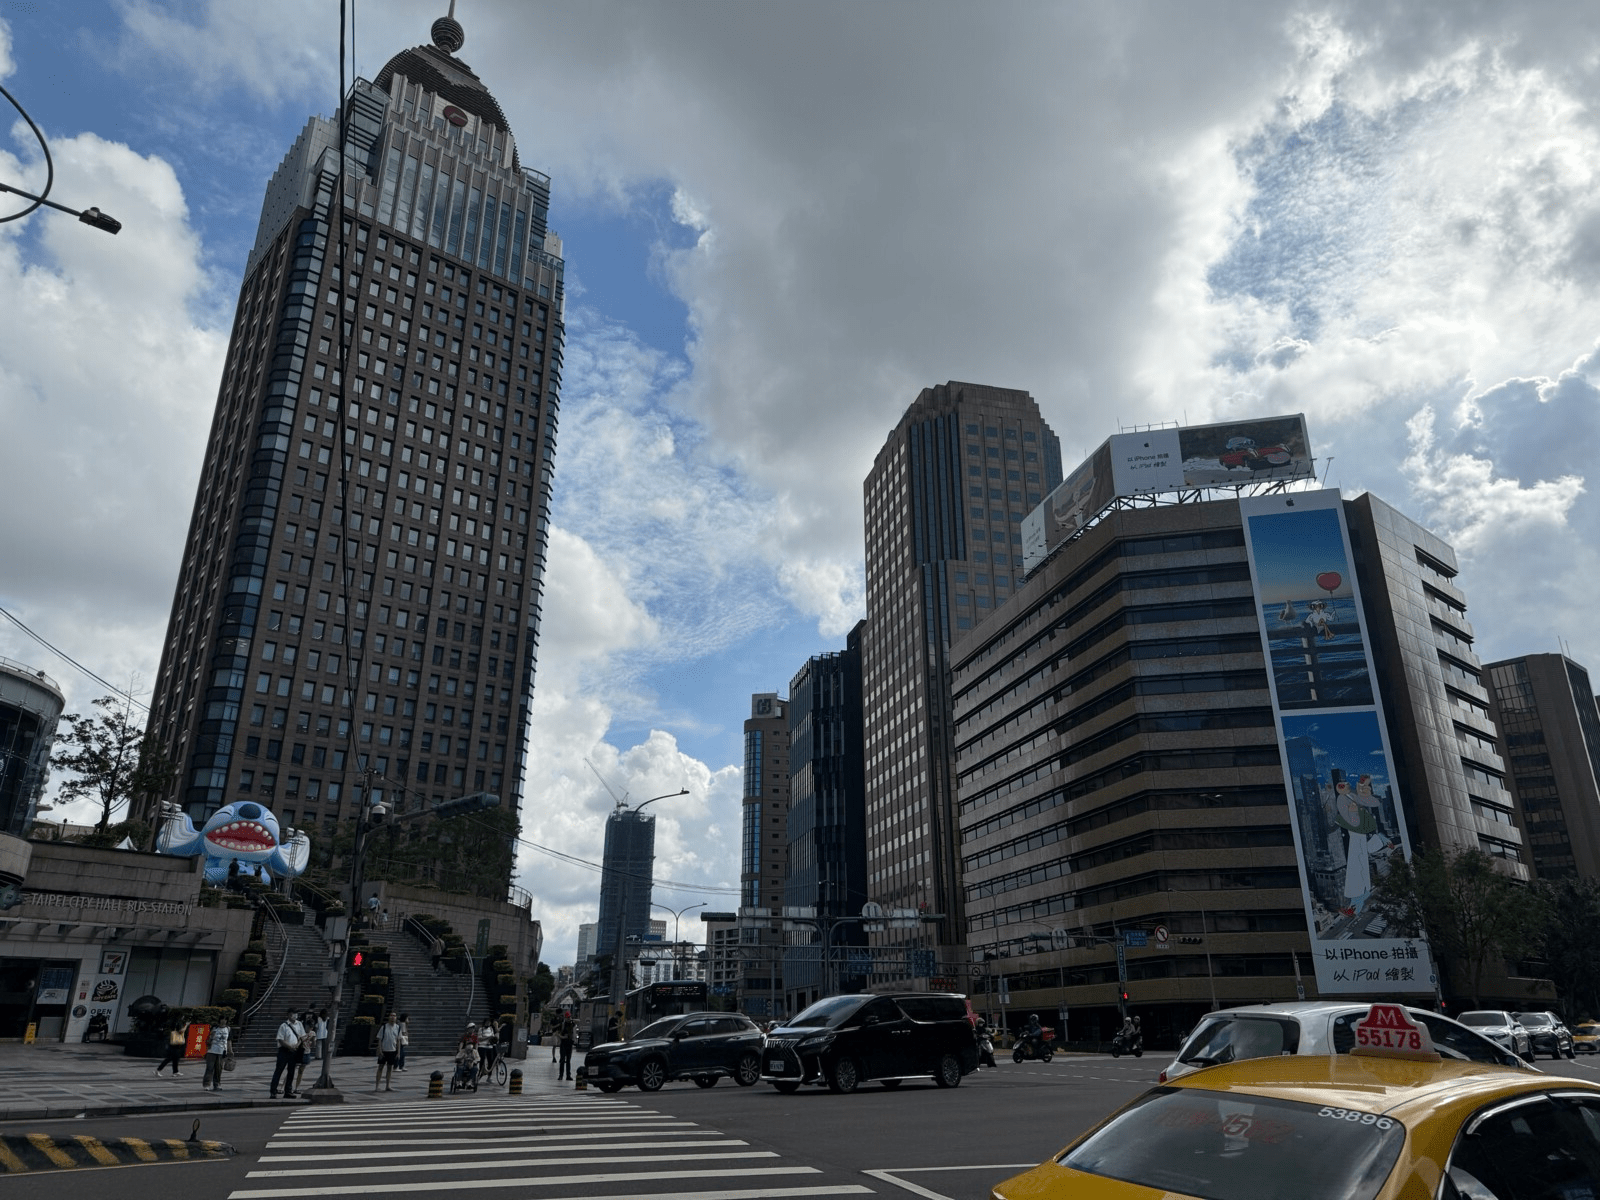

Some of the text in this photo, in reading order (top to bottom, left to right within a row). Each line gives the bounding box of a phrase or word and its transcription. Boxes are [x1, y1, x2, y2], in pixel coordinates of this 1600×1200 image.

[31, 892, 193, 916] TAIPEI CITY HALL BUS STATION
[1325, 946, 1419, 961] 以 iPhone 拍攝
[1333, 966, 1415, 982] 以 iPad 繪製
[1376, 1009, 1399, 1026] M
[1357, 1028, 1421, 1050] 55178
[1317, 1106, 1394, 1130] 53896
